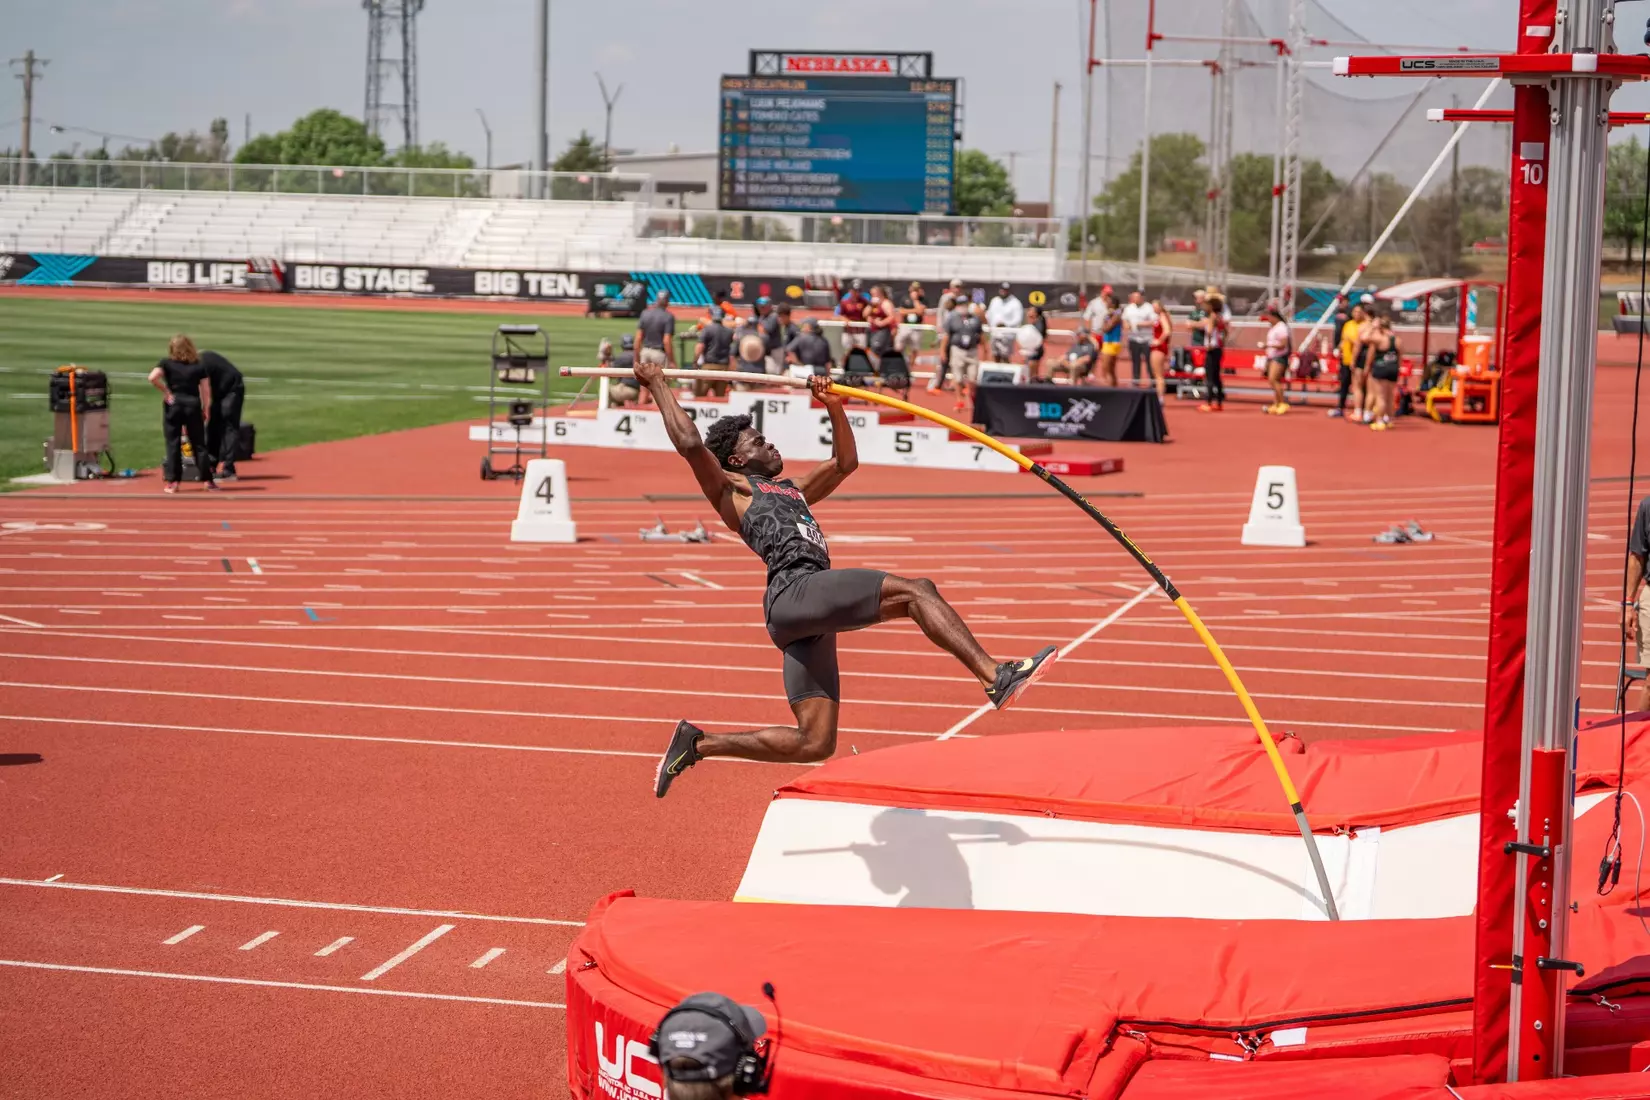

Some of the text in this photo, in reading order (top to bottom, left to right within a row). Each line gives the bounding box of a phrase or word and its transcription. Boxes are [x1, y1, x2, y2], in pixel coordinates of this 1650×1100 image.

[786, 56, 891, 73] NEBRASKA
[1402, 60, 1435, 69] UCS
[1520, 163, 1544, 185] 10
[147, 261, 247, 286] BIG LIFE
[295, 265, 435, 292] BIG STAGE.
[474, 271, 586, 297] BIG TEN.
[615, 414, 647, 436] 4TH
[749, 399, 790, 434] 1ST
[895, 431, 929, 453] 5TH
[535, 475, 555, 505] 4
[1266, 482, 1285, 510] 5
[595, 1020, 667, 1099] UC
